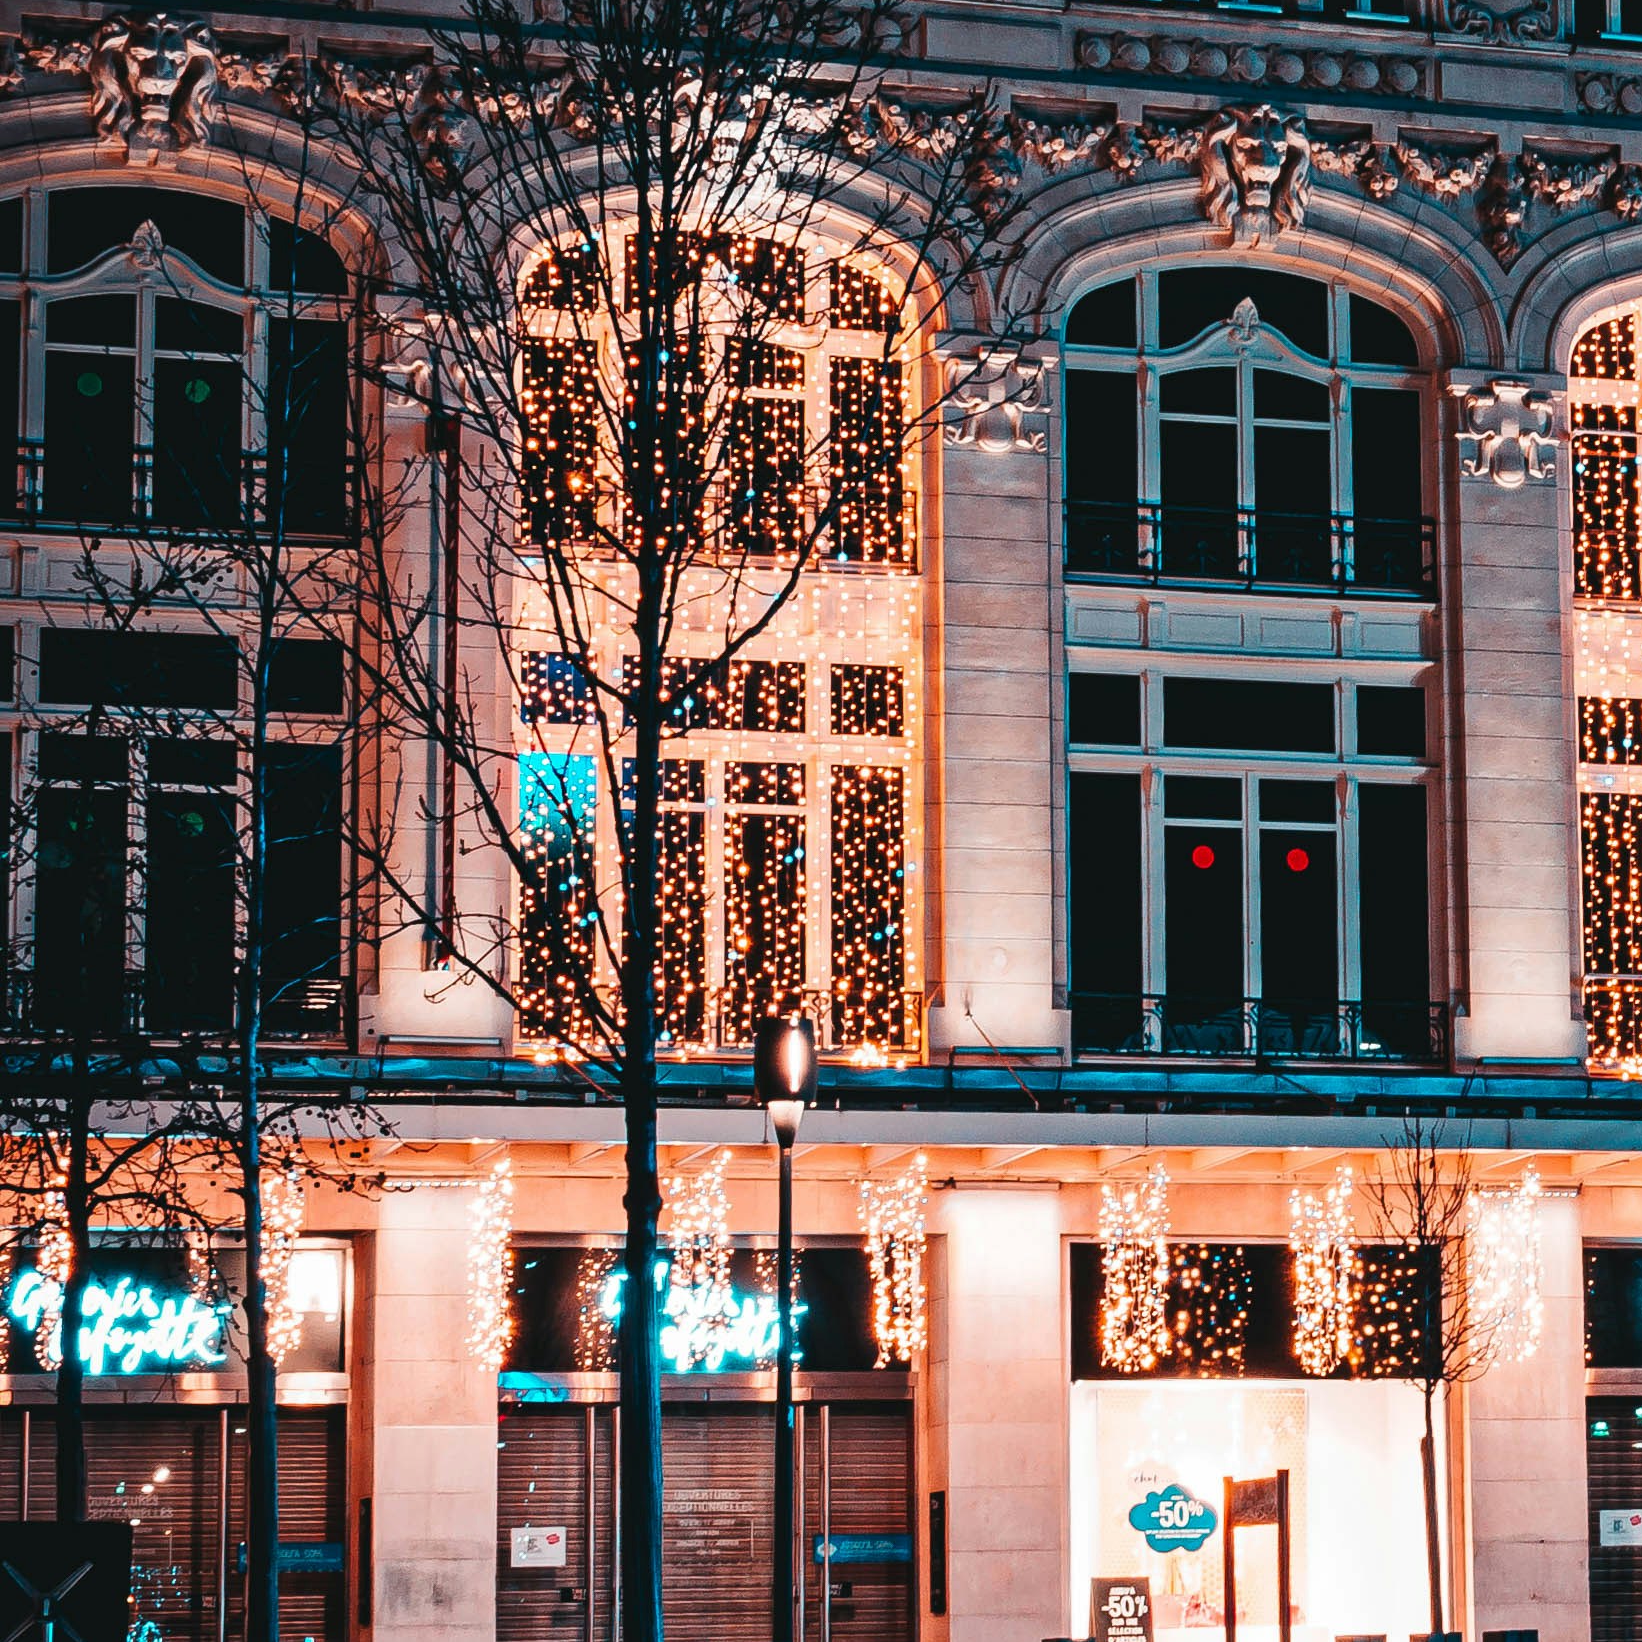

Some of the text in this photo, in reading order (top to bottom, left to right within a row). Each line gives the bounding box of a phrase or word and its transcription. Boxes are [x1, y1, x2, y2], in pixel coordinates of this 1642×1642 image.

[12, 1272, 159, 1331] Gaeries
[1150, 1500, 1205, 1528] -50%
[1101, 1595, 1149, 1617] -50%
